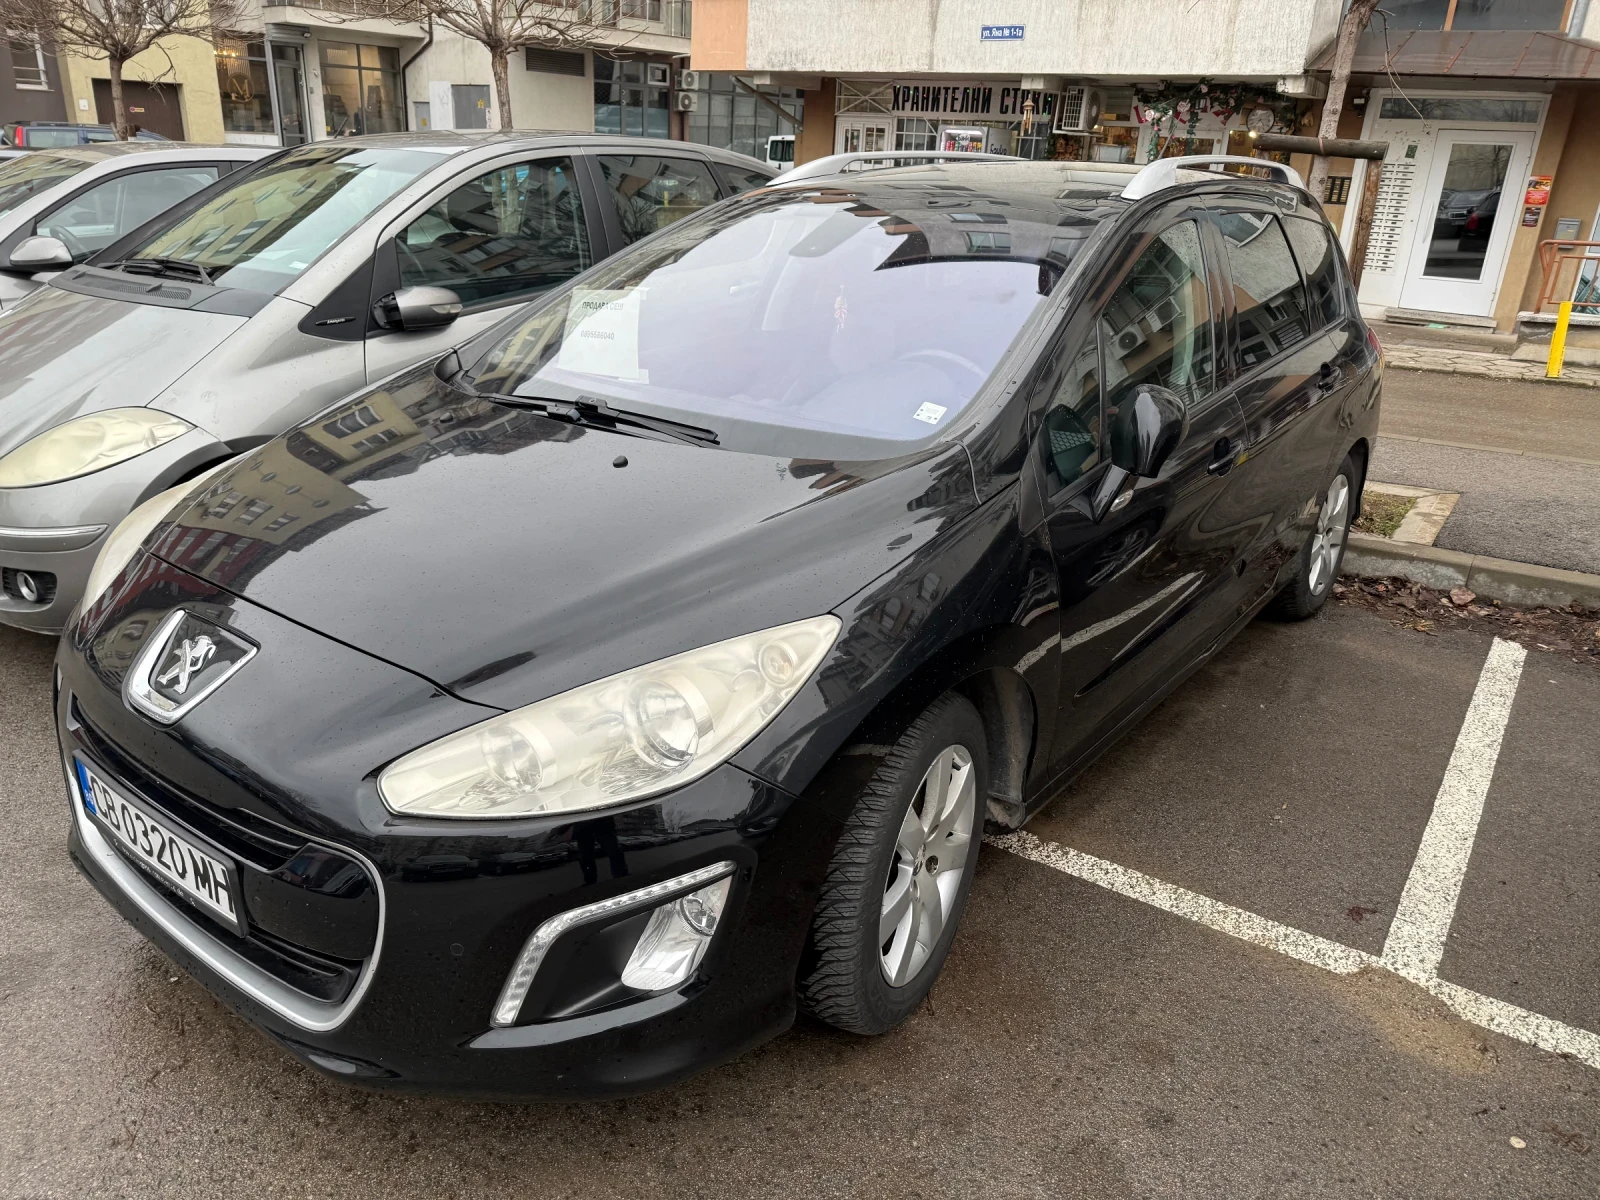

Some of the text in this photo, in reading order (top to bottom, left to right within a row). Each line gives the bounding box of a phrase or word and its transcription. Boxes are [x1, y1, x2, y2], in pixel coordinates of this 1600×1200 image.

[992, 28, 1002, 37] Яна
[892, 86, 992, 113] ХРАНИТЕЛНИ
[121, 802, 188, 881] 0320
